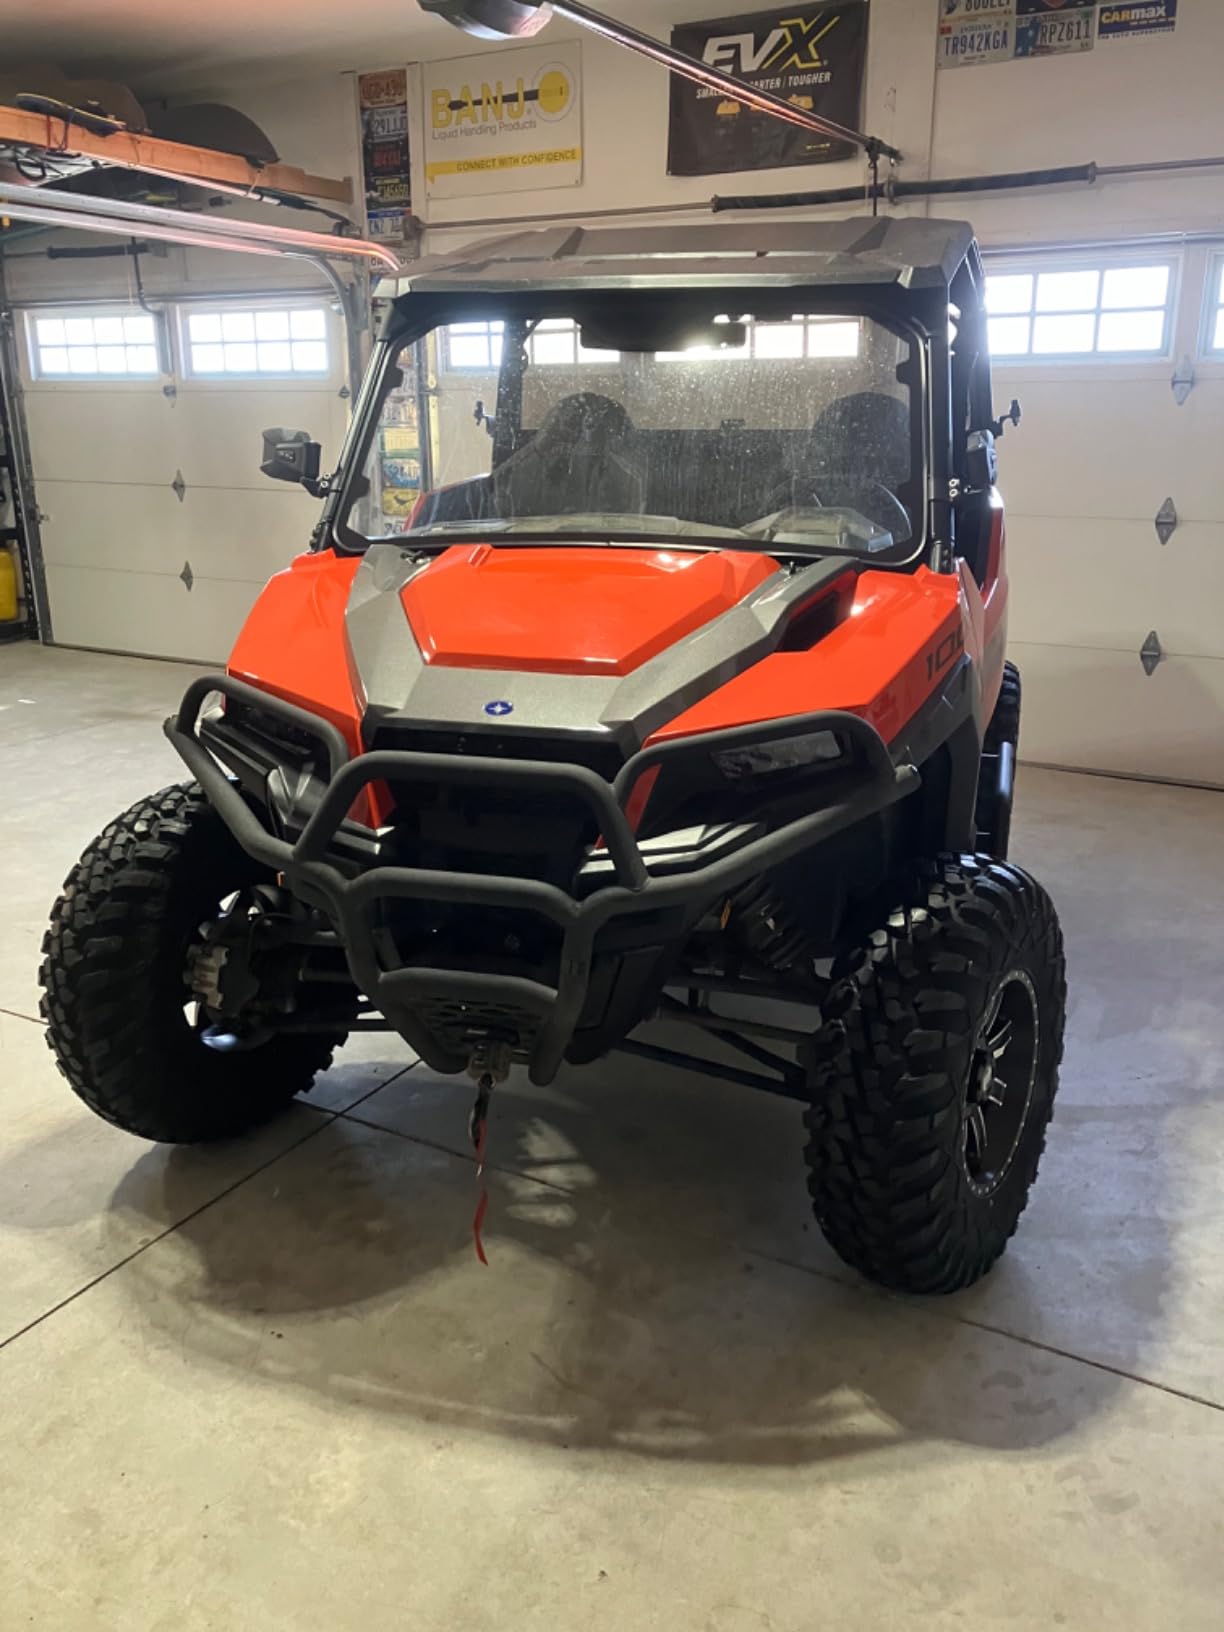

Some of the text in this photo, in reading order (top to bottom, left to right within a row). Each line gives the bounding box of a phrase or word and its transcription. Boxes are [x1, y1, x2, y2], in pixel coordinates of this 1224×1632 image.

[702, 11, 841, 74] EVX
[788, 71, 832, 88] TOUGHER
[432, 120, 537, 142] Liquid Handling Products
[456, 148, 577, 173] CONNECT WITH CONFIDENCE
